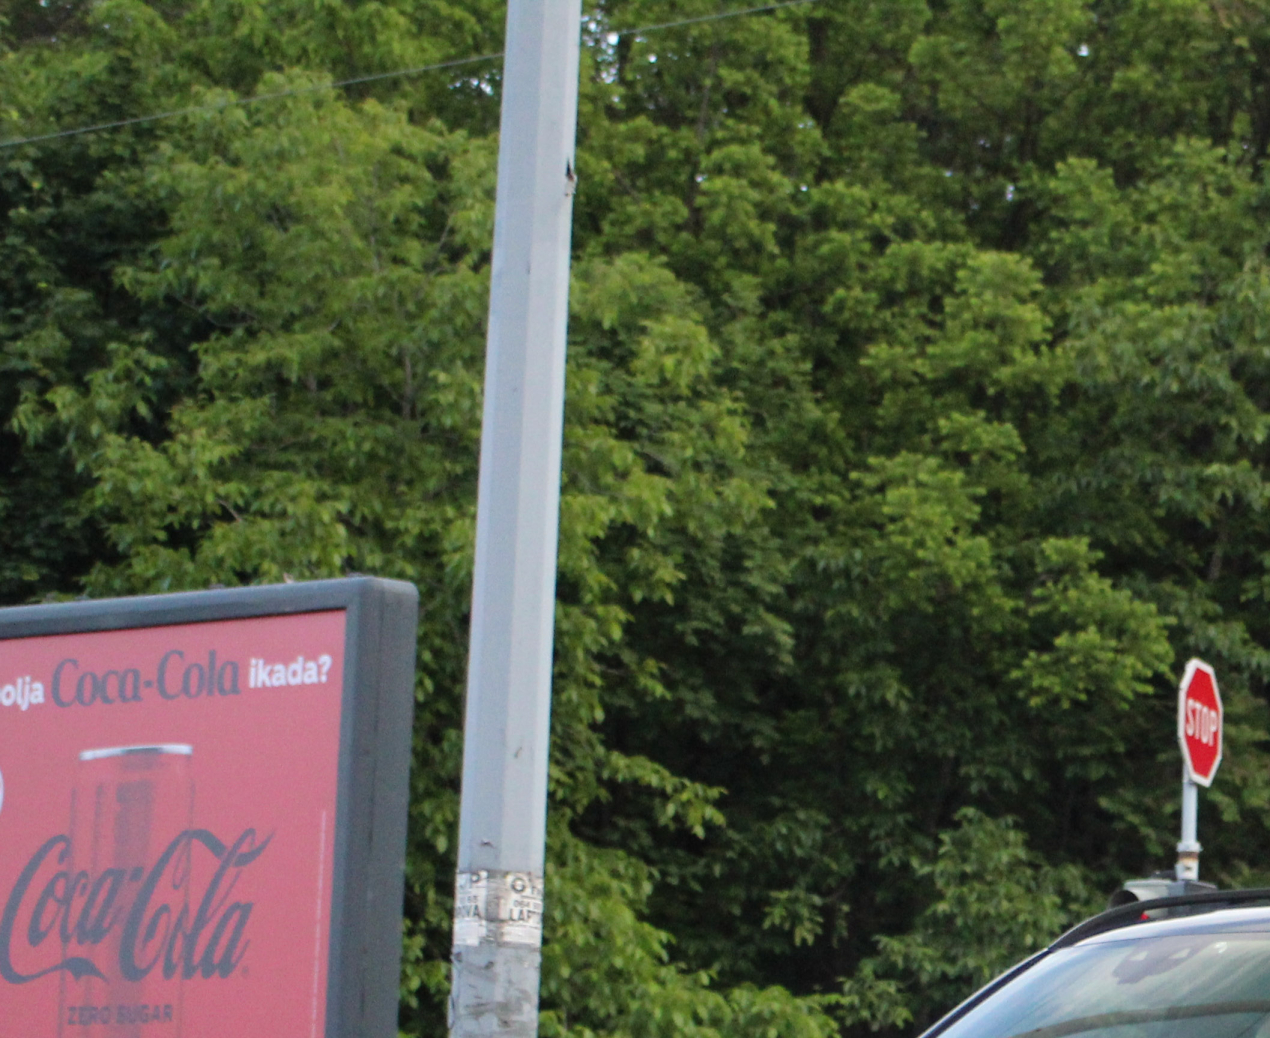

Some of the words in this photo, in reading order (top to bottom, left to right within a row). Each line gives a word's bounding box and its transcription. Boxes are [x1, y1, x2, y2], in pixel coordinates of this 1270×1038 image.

[0, 675, 45, 711] olja
[51, 649, 241, 707] Coca-Cola
[249, 654, 332, 688] ikada?
[1186, 698, 1219, 747] STOP
[0, 828, 277, 984] Coca-Cola
[67, 1005, 111, 1025] ZERO
[116, 1004, 173, 1024] SUGAR
